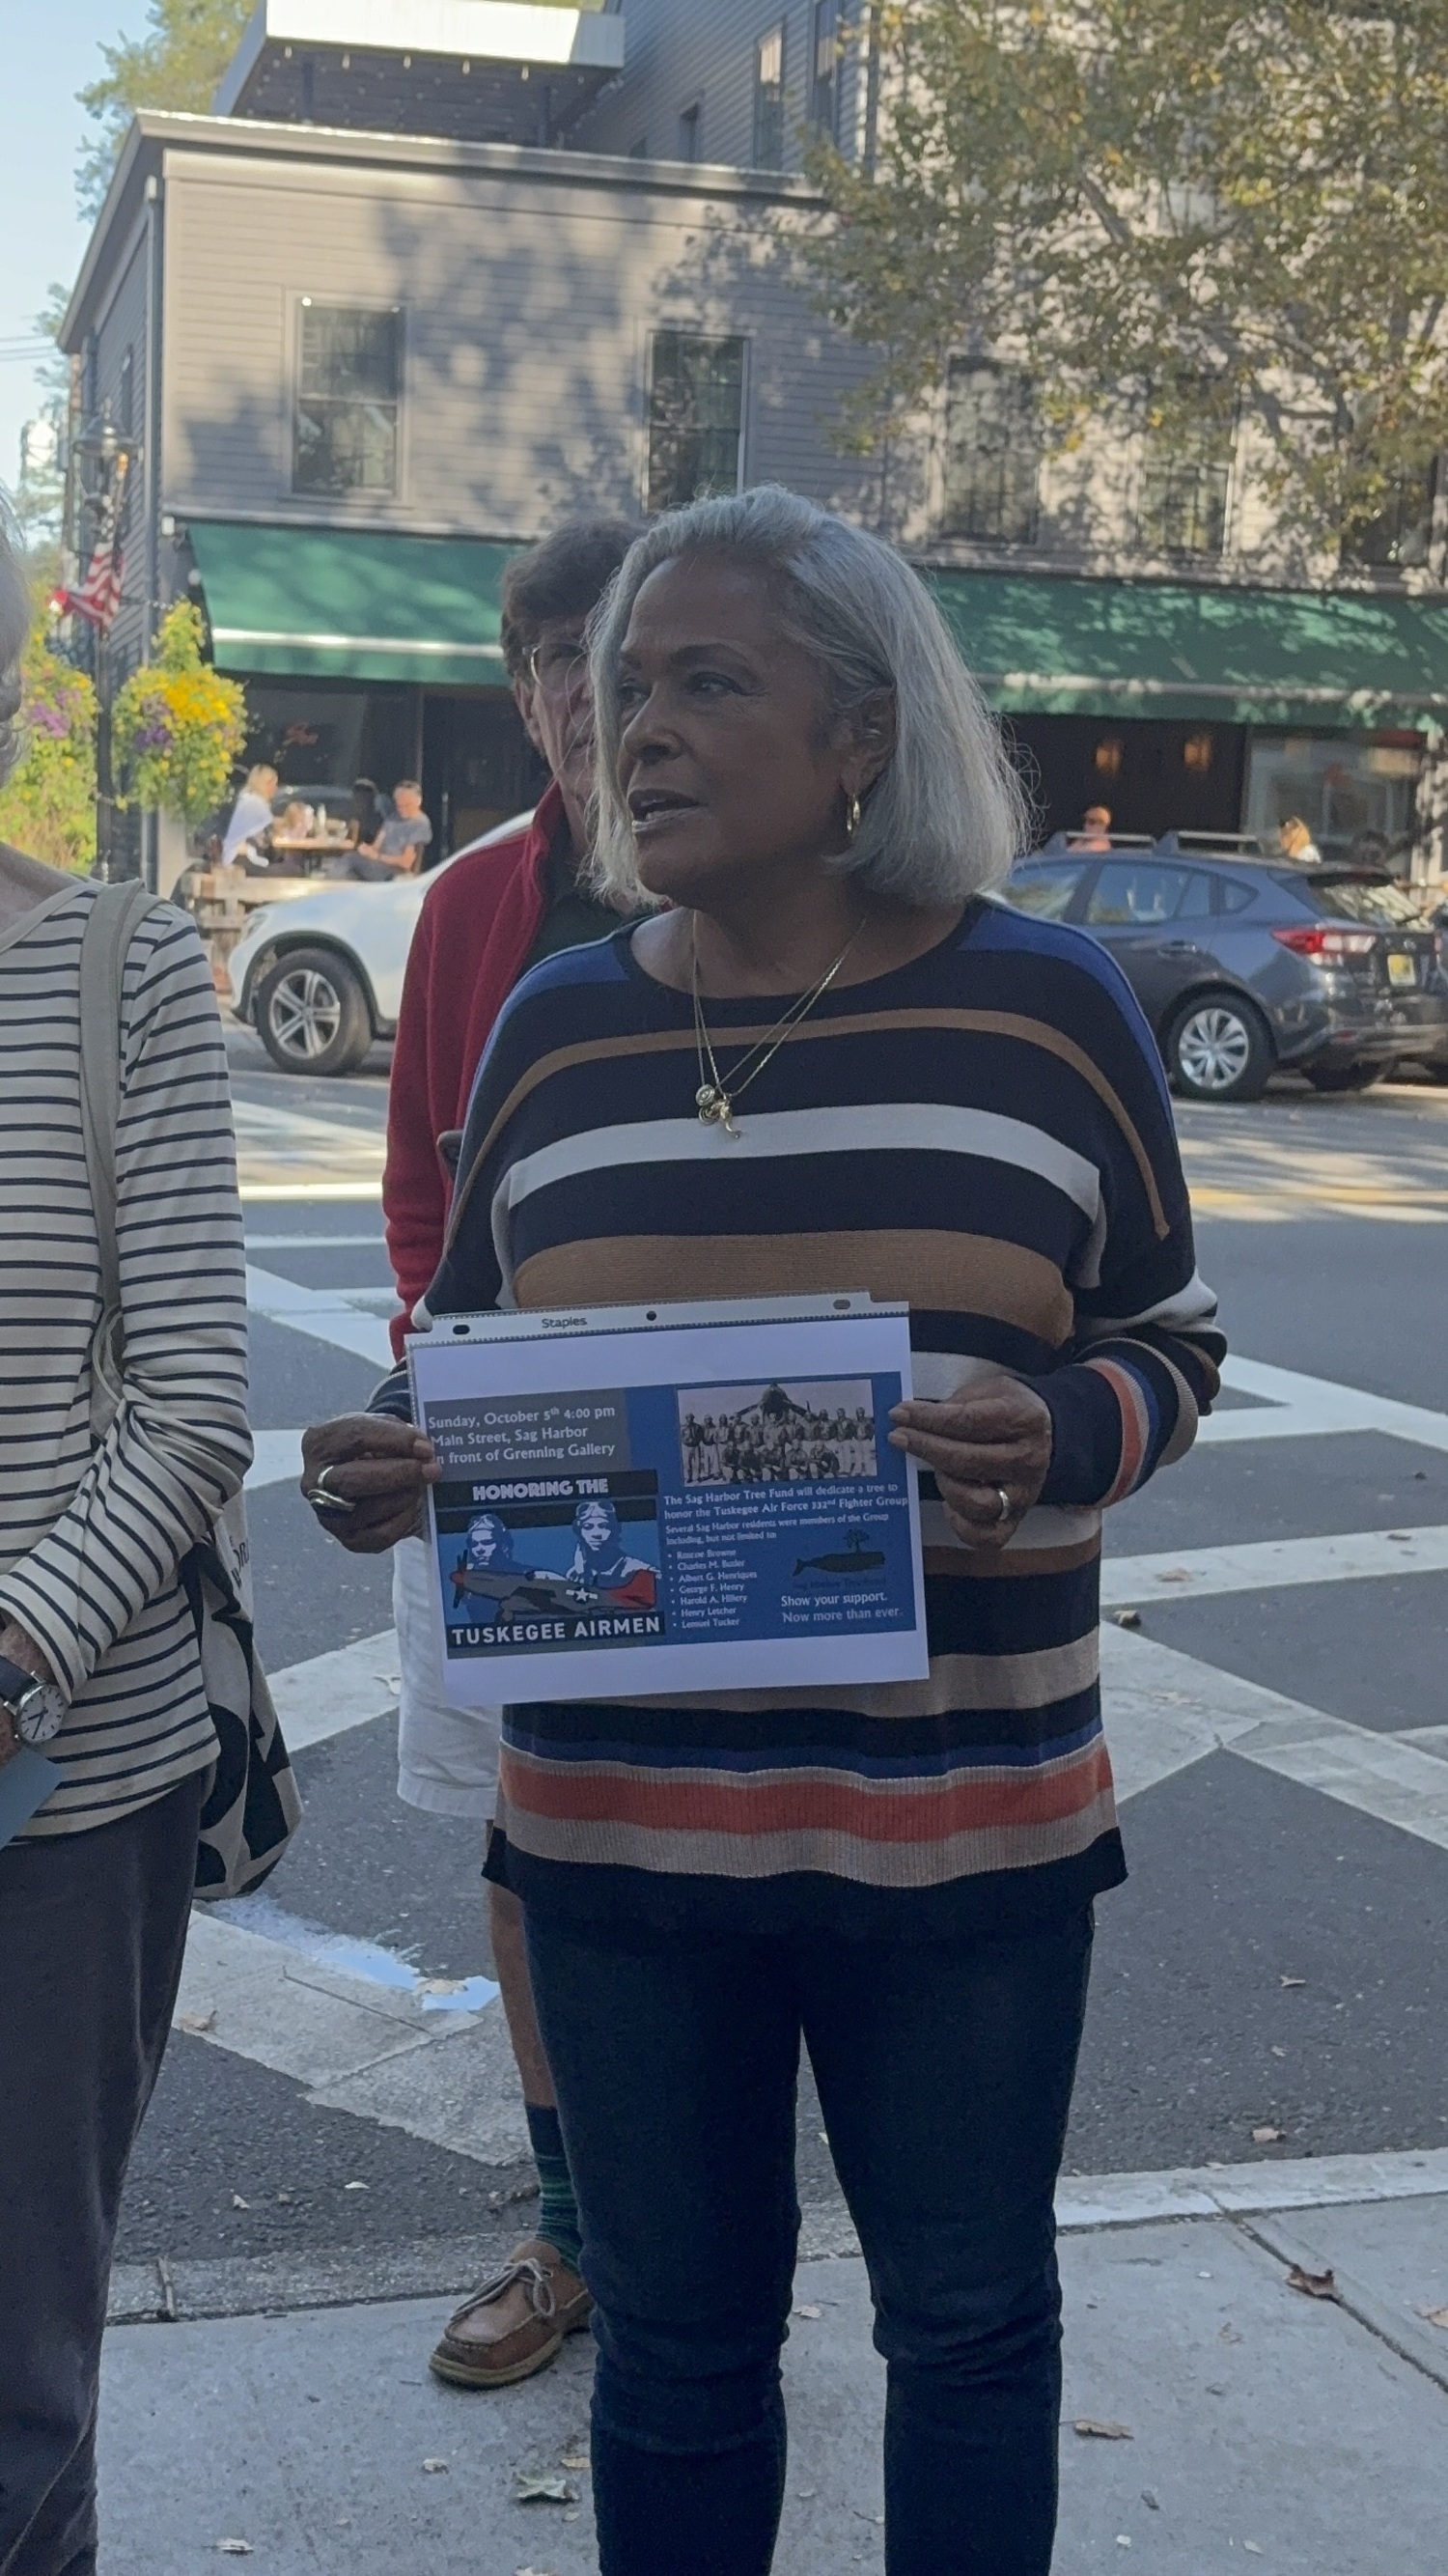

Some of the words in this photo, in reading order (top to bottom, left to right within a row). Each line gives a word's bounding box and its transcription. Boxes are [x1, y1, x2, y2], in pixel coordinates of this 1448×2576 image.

[542, 1317, 588, 1329] Staples
[428, 1414, 480, 1429] Sunday,
[484, 1411, 540, 1425] October
[543, 1406, 560, 1420] 5th
[564, 1408, 590, 1419] 4:00
[594, 1407, 616, 1419] pm
[430, 1434, 463, 1446] Main
[467, 1432, 512, 1444] Street,
[515, 1429, 538, 1442] Sag
[542, 1426, 589, 1440] Harbor
[449, 1451, 482, 1464] front
[485, 1448, 500, 1461] of
[503, 1445, 565, 1460] Grenning
[568, 1442, 616, 1457] Gallery
[472, 1479, 574, 1501] HONORING
[575, 1478, 609, 1495] THE
[663, 1496, 682, 1505] The
[684, 1494, 703, 1504] Sag
[705, 1491, 741, 1502] Harbor
[743, 1489, 766, 1499] Tree
[768, 1487, 794, 1498] Fund
[796, 1486, 813, 1497] will
[816, 1485, 855, 1496] dedicate
[866, 1484, 885, 1493] tree
[887, 1483, 899, 1492] to
[664, 1510, 693, 1520] honor
[695, 1508, 711, 1518] the
[713, 1505, 759, 1516] Tuskegee
[762, 1502, 778, 1513] Air
[781, 1501, 809, 1512] Force
[839, 1498, 874, 1509] Fighter
[876, 1496, 908, 1507] Group
[665, 1525, 694, 1534] Several
[695, 1523, 710, 1533] Sag
[711, 1521, 739, 1531] Harbor
[741, 1519, 777, 1528] residents
[837, 1514, 847, 1524] of
[848, 1514, 862, 1523] the
[863, 1512, 889, 1523] Group
[706, 1534, 719, 1544] but
[721, 1533, 736, 1542] not
[720, 1582, 745, 1592] Henry
[781, 1594, 811, 1607] Show
[814, 1595, 840, 1608] your
[843, 1591, 888, 1606] support.
[681, 1609, 706, 1618] Henry
[712, 1617, 740, 1627] Tucker
[782, 1611, 810, 1623] Now
[813, 1611, 843, 1622] more
[847, 1608, 872, 1620] than
[452, 1622, 566, 1645] TUSKEGEE
[574, 1616, 660, 1638] AIRMEN
